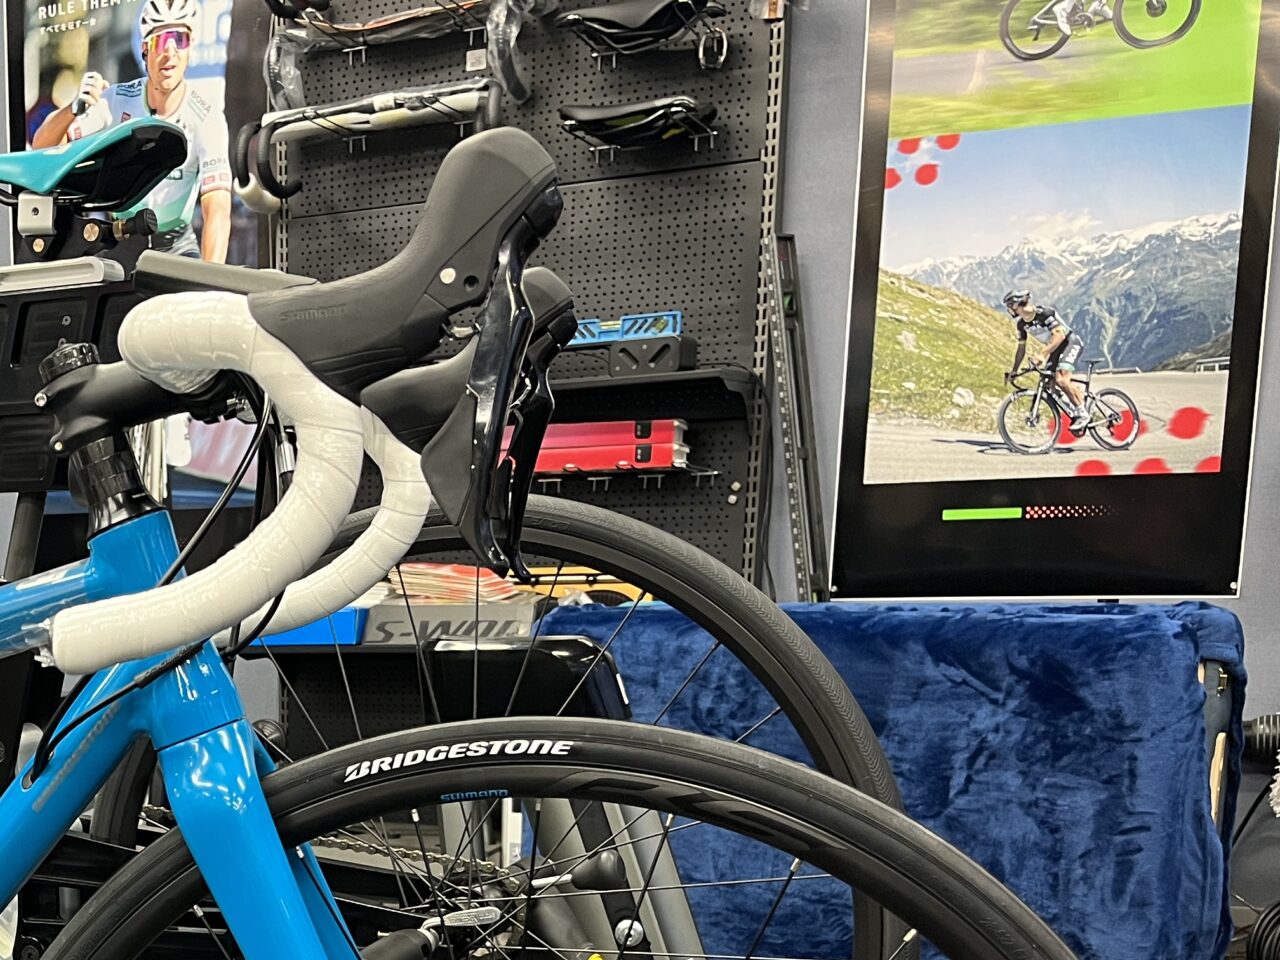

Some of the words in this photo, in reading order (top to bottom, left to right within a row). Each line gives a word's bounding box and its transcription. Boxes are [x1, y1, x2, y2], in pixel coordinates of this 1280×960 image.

[38, 0, 75, 19] RULE
[344, 740, 574, 783] BRIDGESTONE
[440, 789, 510, 802] SHIMANO
